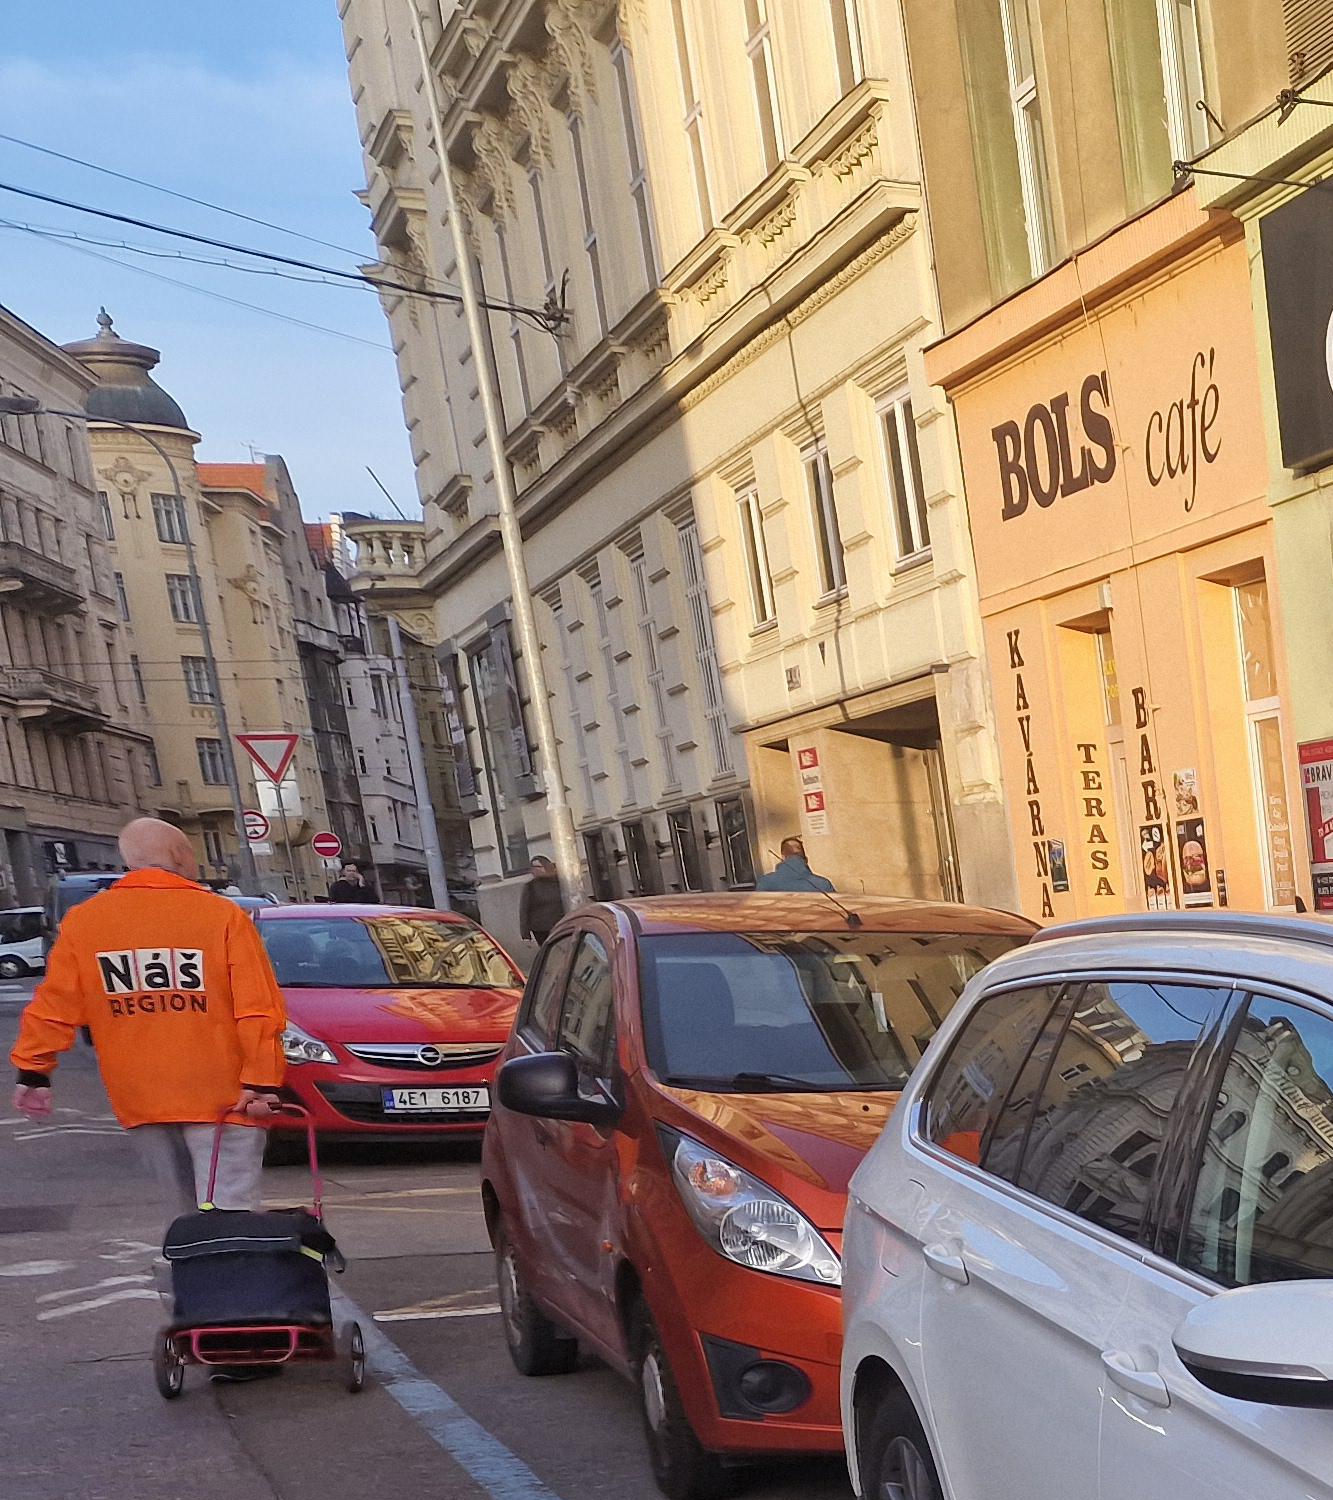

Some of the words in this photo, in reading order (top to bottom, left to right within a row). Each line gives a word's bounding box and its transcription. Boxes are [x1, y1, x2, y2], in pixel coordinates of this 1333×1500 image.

[991, 370, 1116, 522] BOLS
[1146, 347, 1221, 512] café
[1006, 628, 1055, 919] KAVÁRNA
[1076, 743, 1116, 896] TERASA
[1132, 686, 1161, 822] BAR
[98, 952, 201, 992] Náš
[108, 994, 208, 1018] REGION
[398, 1091, 428, 1106] 4E1
[441, 1091, 480, 1105] 6187
